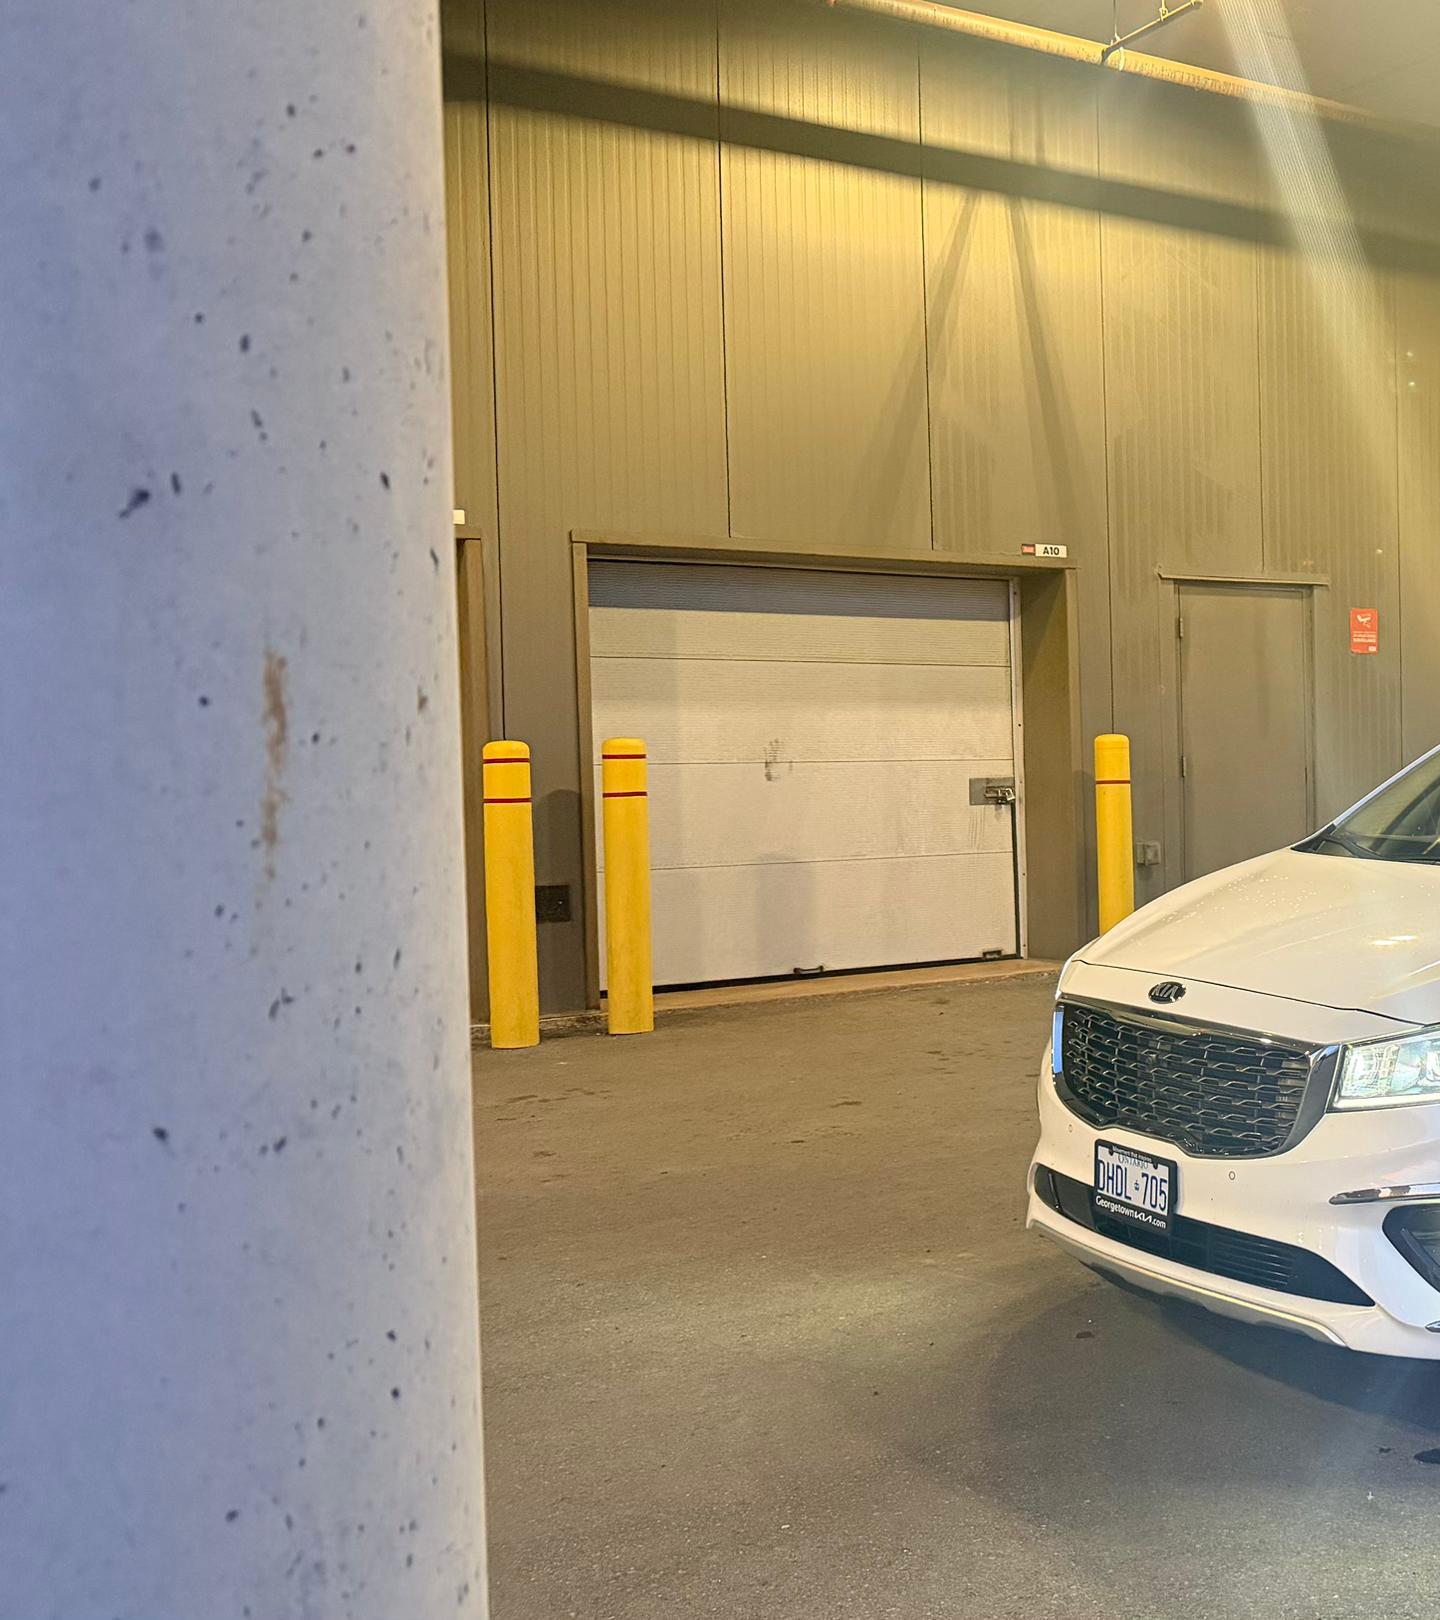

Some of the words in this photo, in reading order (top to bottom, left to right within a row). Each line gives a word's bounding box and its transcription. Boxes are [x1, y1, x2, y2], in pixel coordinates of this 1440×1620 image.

[1043, 546, 1060, 556] A10
[1150, 982, 1180, 999] KIA
[1097, 1159, 1132, 1200] DHDL
[1141, 1172, 1168, 1212] 705
